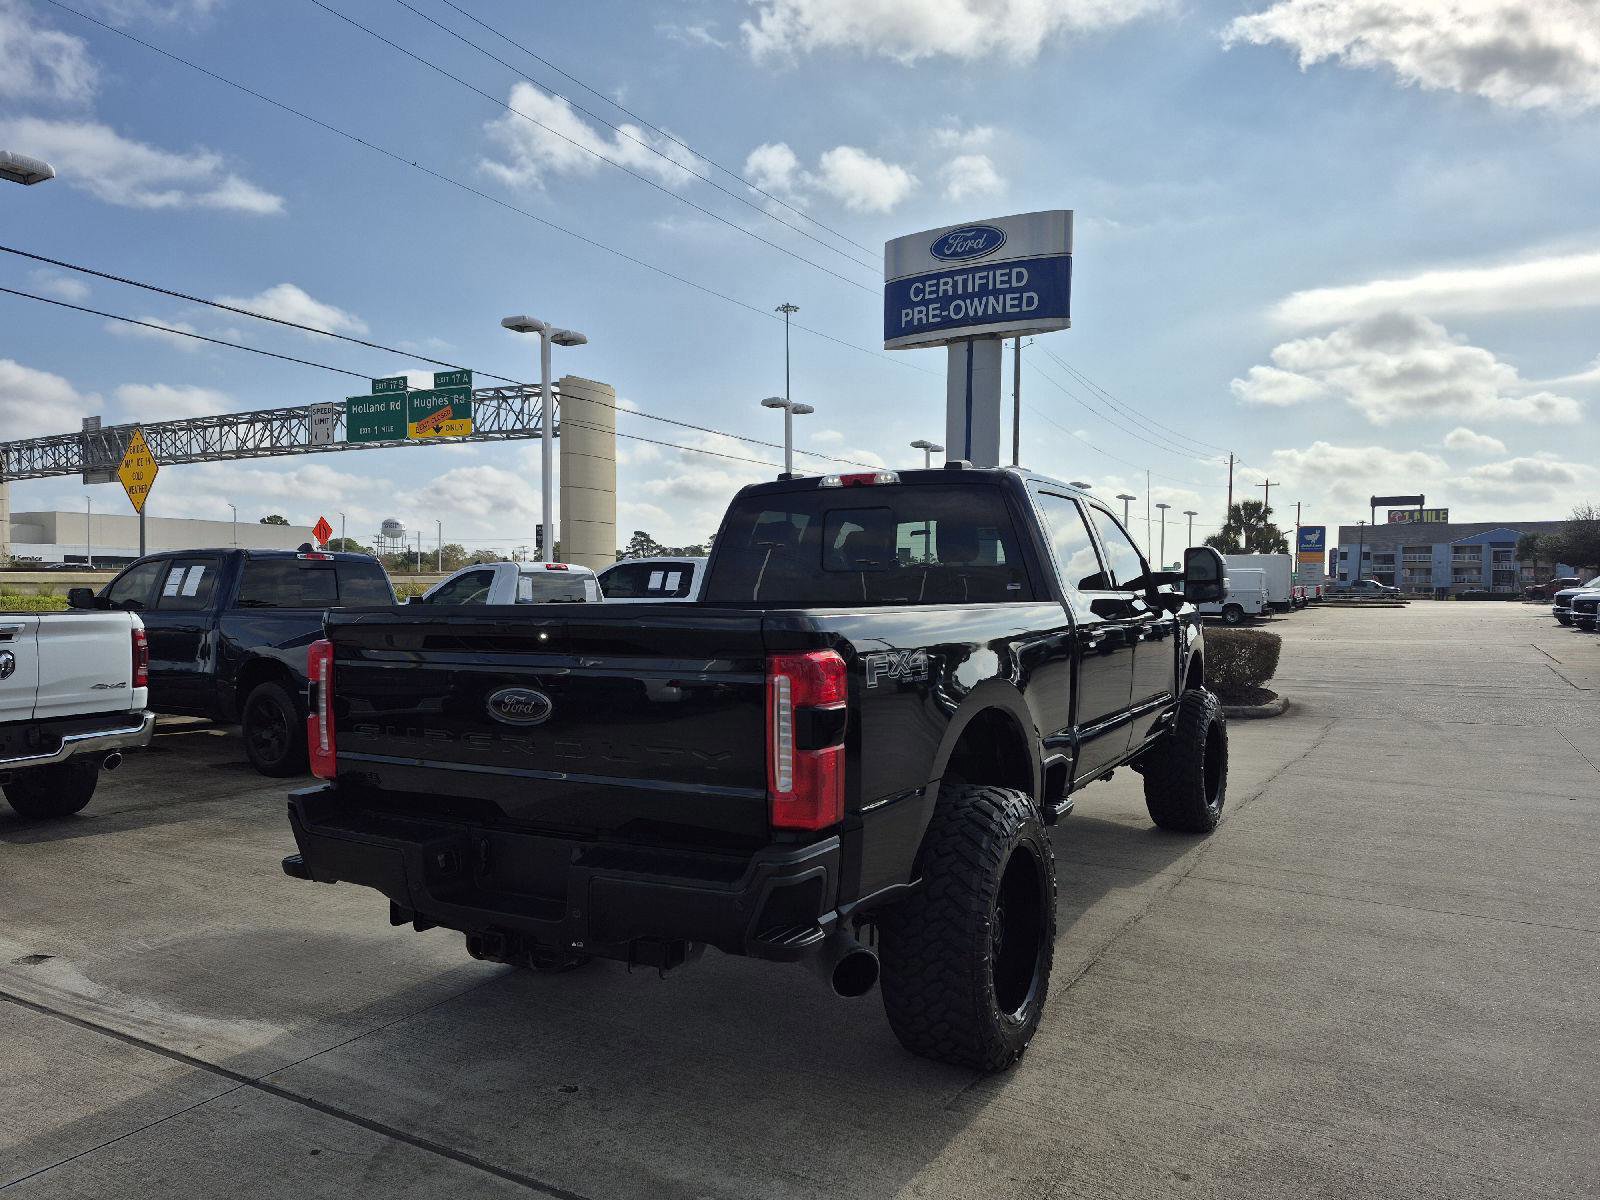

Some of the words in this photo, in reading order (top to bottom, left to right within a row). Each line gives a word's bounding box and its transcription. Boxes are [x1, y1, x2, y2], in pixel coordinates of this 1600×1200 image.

[944, 231, 988, 255] Ford
[909, 267, 1029, 302] CERTIFIED
[901, 291, 1039, 328] PRE-OWNED
[376, 381, 387, 390] EXIT
[437, 376, 449, 384] EXIT
[352, 402, 386, 414] Holland
[390, 400, 401, 411] Rd
[414, 395, 449, 409] Hughes
[453, 393, 465, 405] Rd
[312, 407, 332, 416] SPEED
[314, 417, 330, 426] LIMIT
[445, 423, 464, 432] ONLY
[129, 485, 147, 494] WEATHER
[866, 647, 929, 689] FX4
[500, 695, 536, 714] Ford
[351, 721, 536, 757] SUPER
